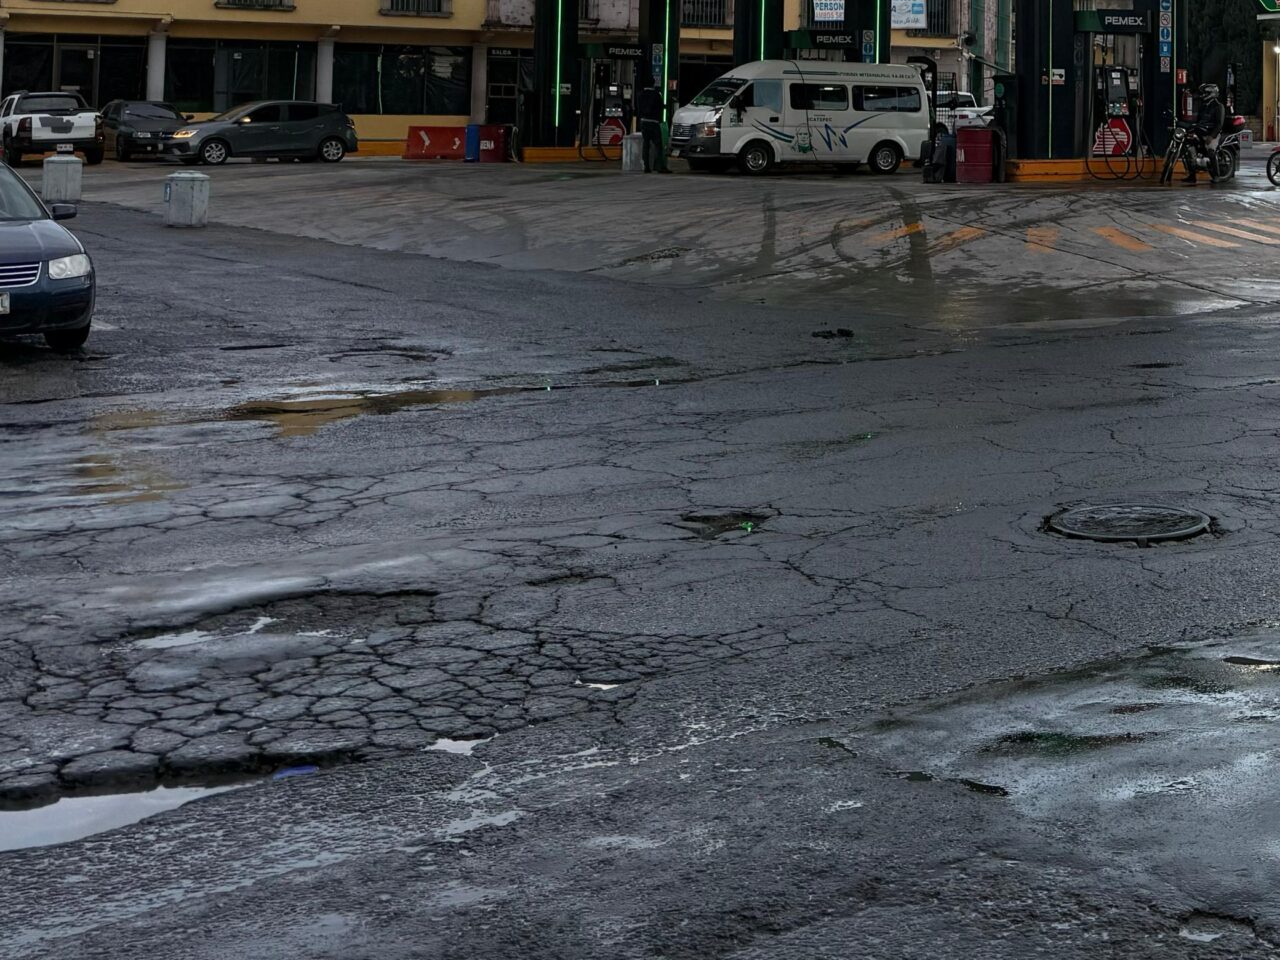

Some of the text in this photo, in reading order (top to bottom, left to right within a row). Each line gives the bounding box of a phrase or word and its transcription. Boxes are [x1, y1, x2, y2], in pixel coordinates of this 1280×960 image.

[1104, 16, 1143, 26] PEMEX
[816, 35, 852, 44] PEMEX
[608, 47, 642, 57] PEMEX
